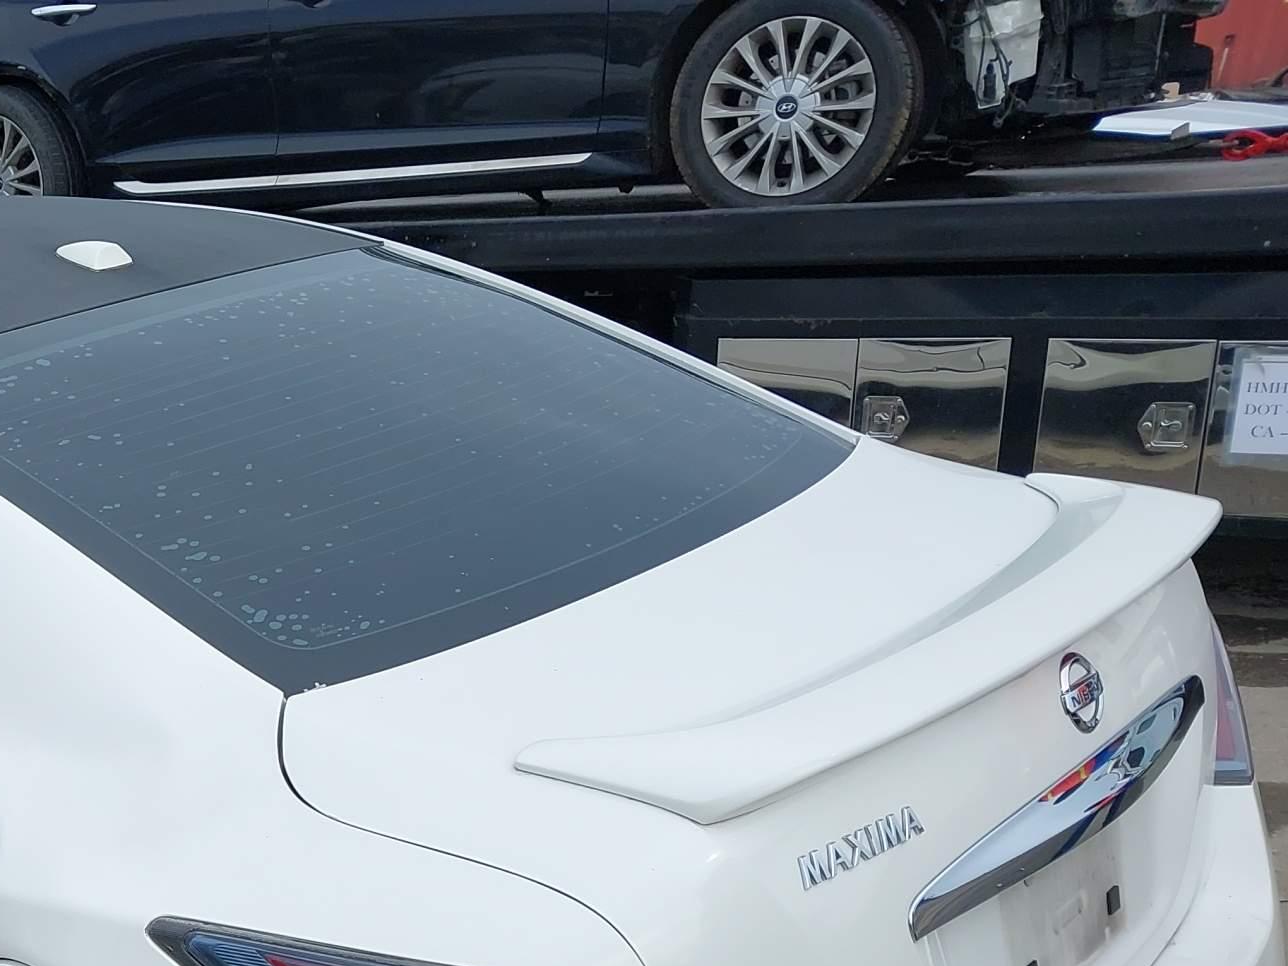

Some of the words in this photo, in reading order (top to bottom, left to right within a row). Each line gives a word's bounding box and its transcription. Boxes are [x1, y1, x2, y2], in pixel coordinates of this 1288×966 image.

[1244, 403, 1282, 416] DOT
[1251, 425, 1274, 438] CA
[796, 805, 925, 891] MAXIMA
